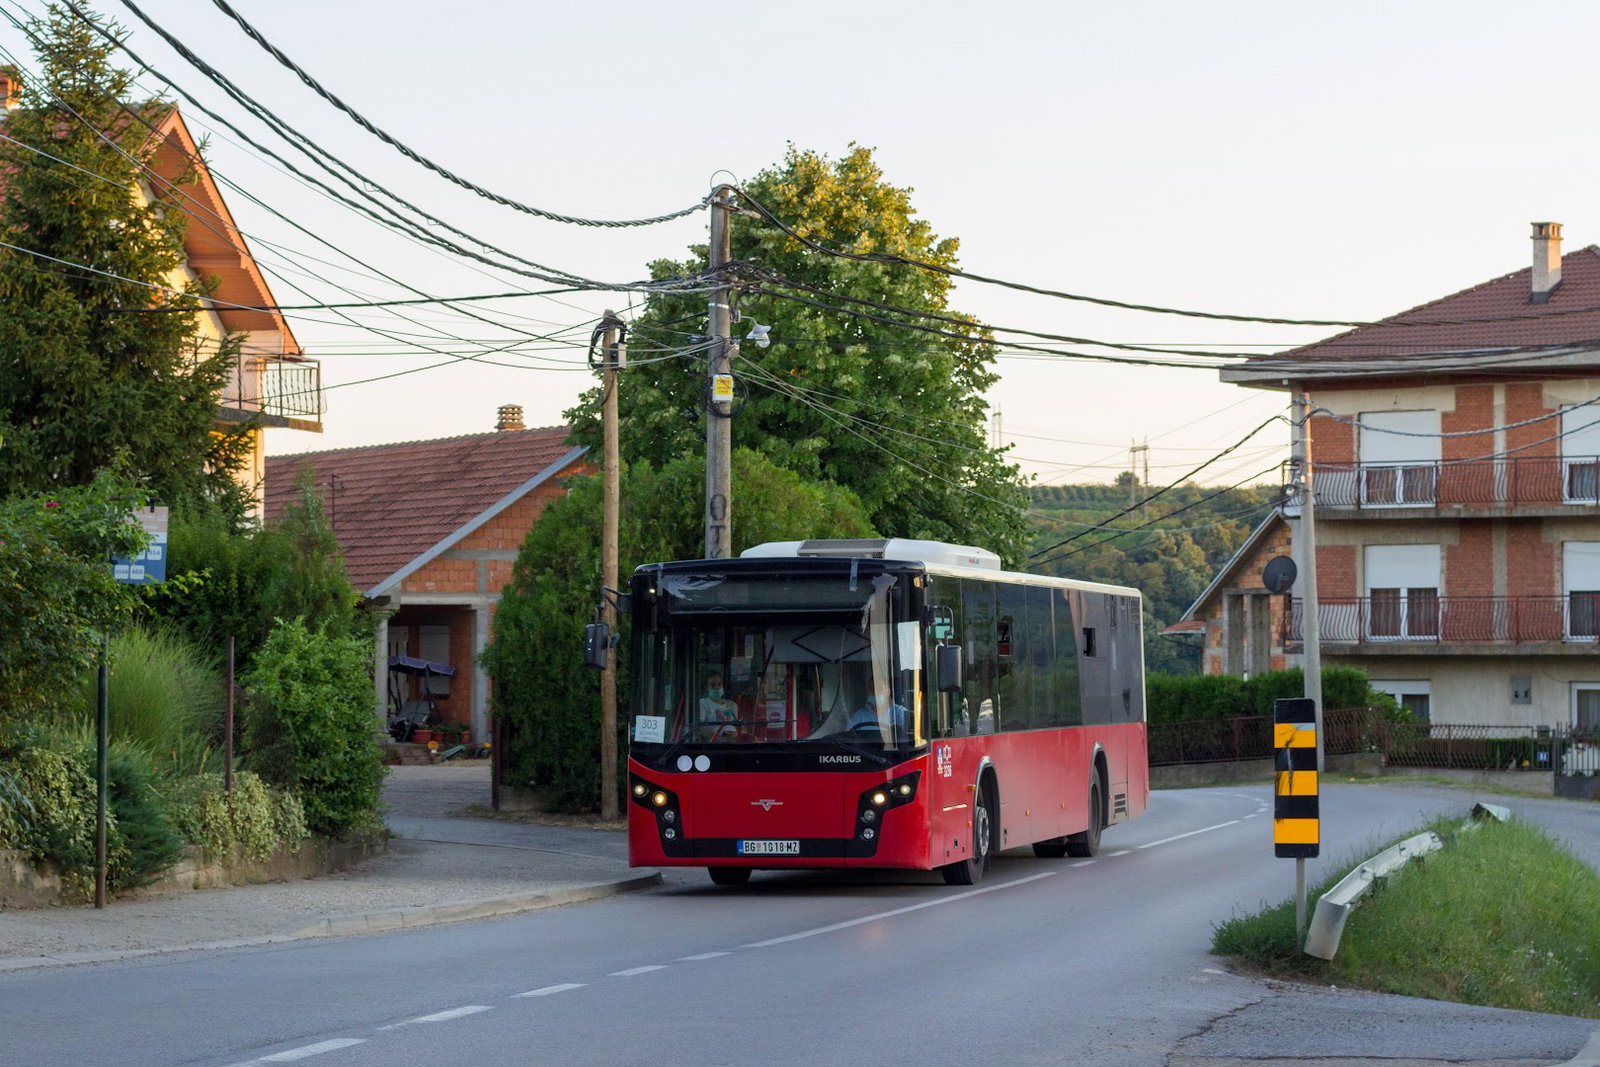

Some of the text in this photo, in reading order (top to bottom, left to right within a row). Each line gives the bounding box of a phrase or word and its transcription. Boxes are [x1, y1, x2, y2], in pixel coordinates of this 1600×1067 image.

[641, 718, 658, 730] 303
[819, 755, 862, 764] IKARBUS
[744, 842, 756, 852] BG
